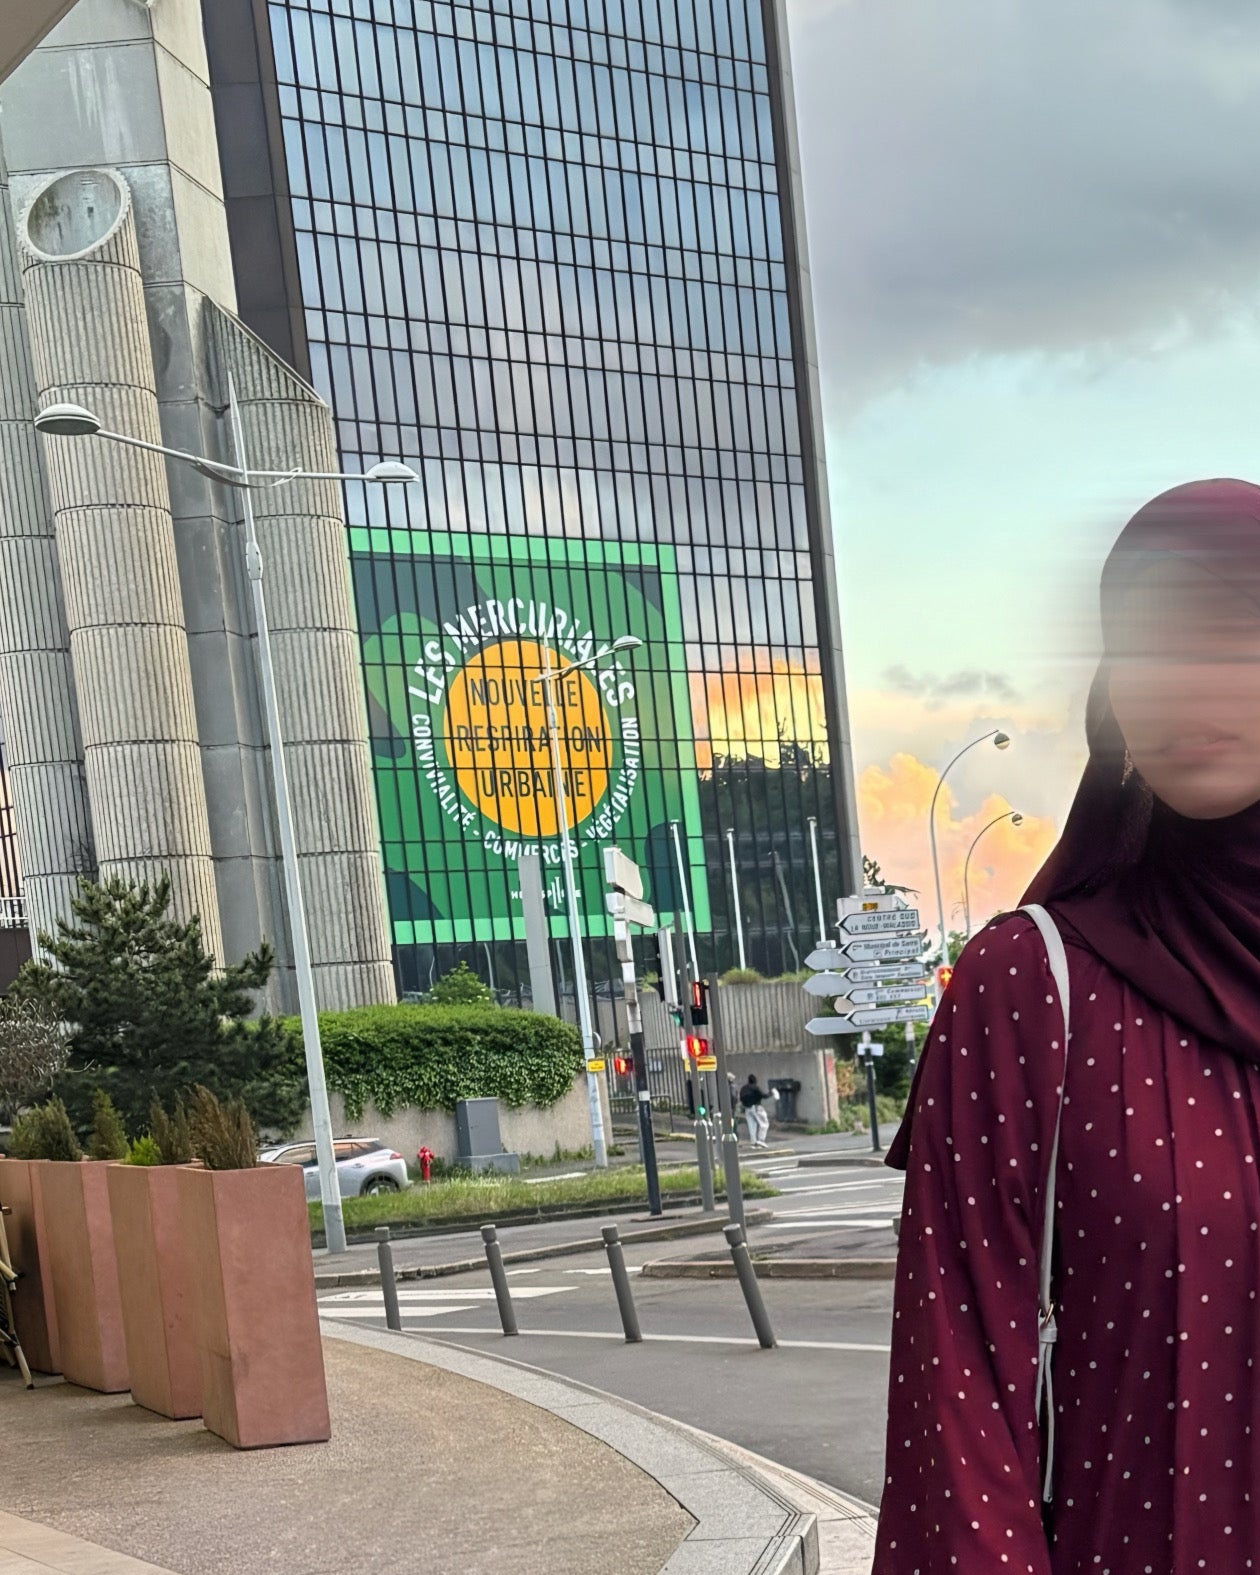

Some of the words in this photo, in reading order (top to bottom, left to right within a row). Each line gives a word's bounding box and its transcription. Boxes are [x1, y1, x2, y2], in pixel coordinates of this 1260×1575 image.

[408, 640, 456, 705] LES
[443, 597, 635, 707] MERCURIALES
[470, 678, 578, 707] NOUVELLE
[456, 725, 601, 753] RESPIRAON
[412, 713, 477, 832] CONVIVIALITÉ
[585, 717, 640, 843] VÉGÉTALISATION
[481, 769, 586, 798] URBAINE
